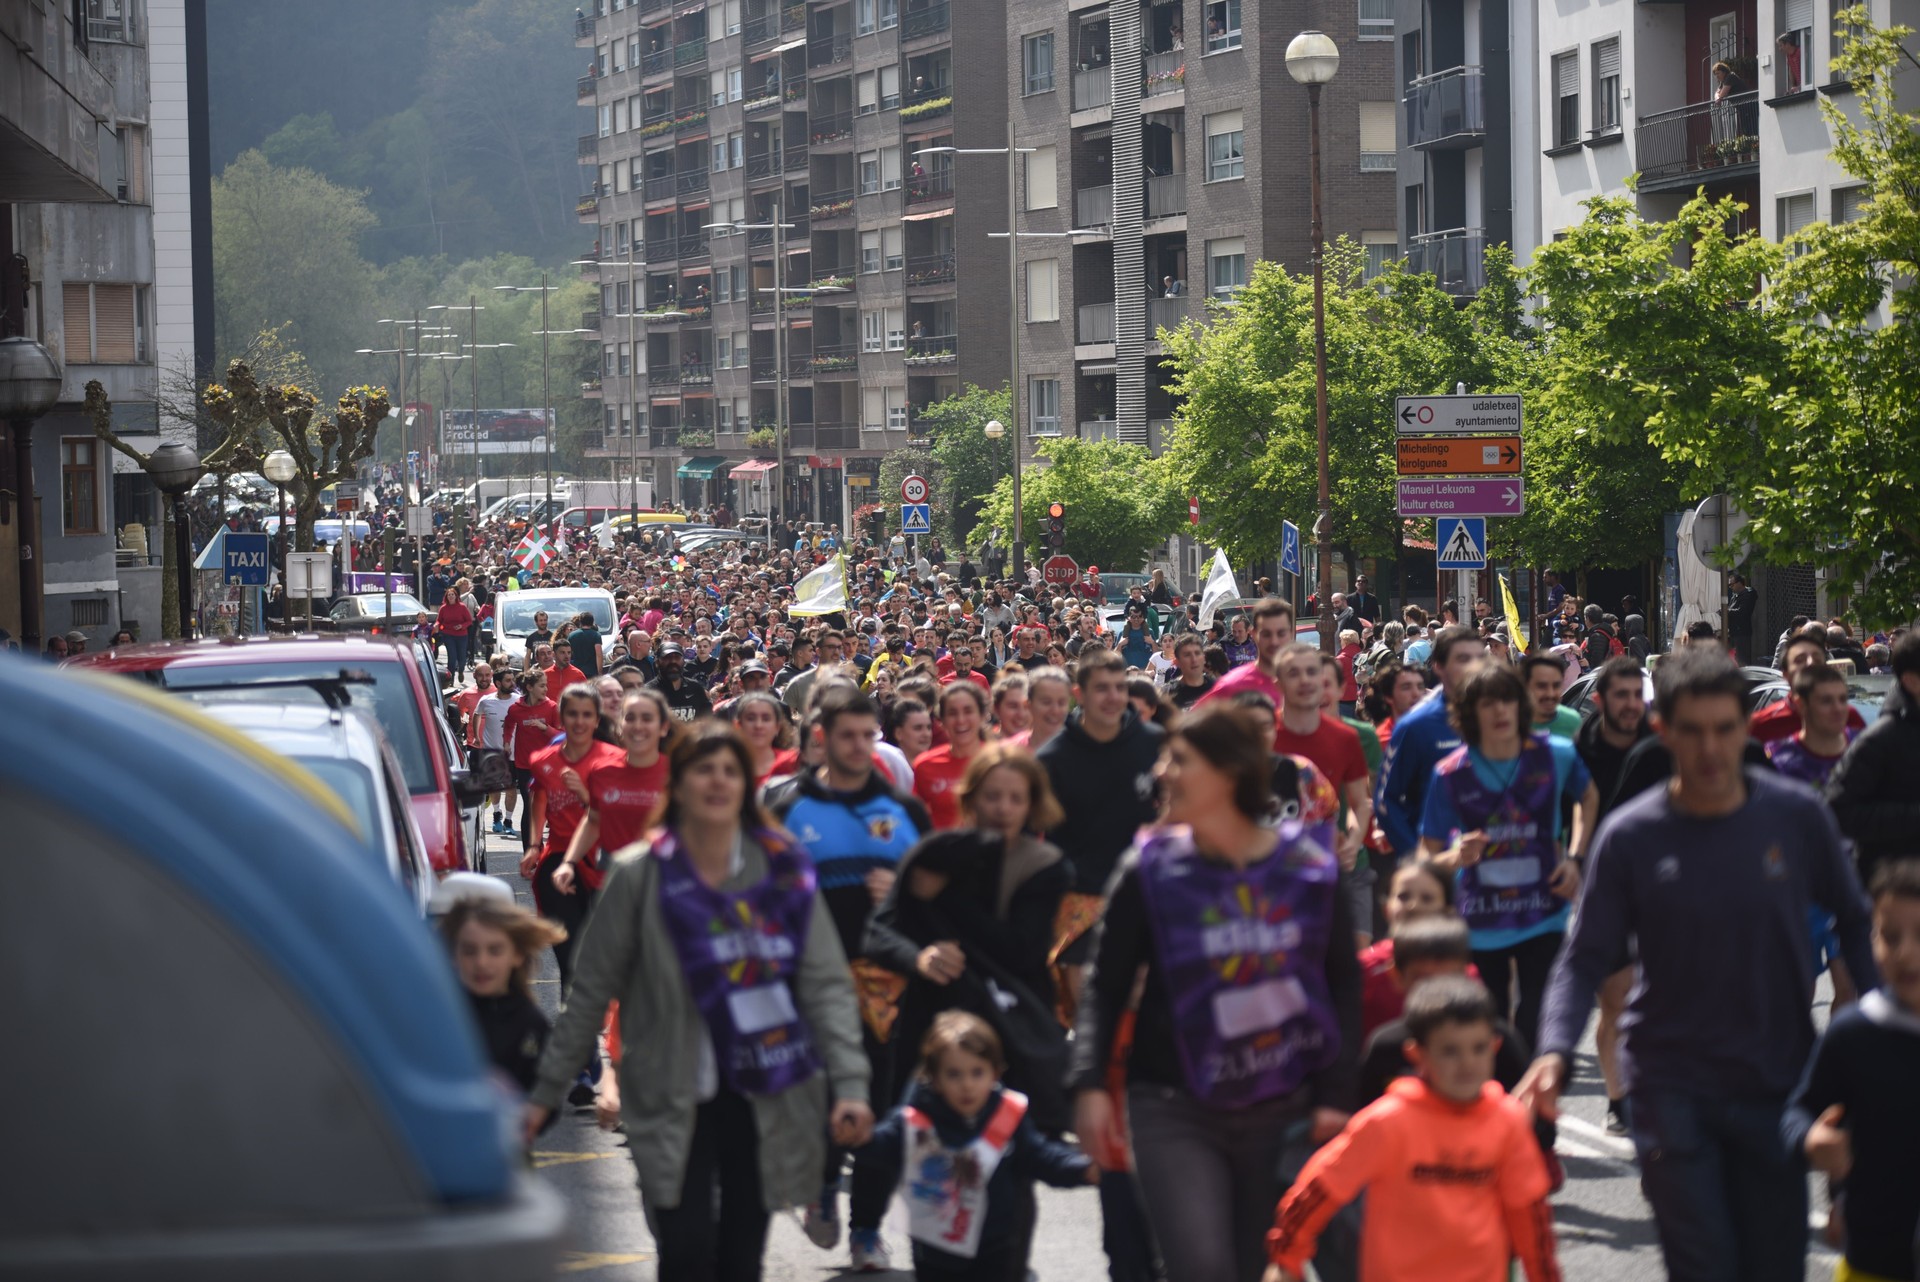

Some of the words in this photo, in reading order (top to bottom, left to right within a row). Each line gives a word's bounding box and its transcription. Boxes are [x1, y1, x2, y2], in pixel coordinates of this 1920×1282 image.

[1472, 401, 1517, 411] udaletxea
[1455, 416, 1518, 428] ayuntamiento
[1400, 444, 1449, 455] Michelingo
[1400, 458, 1448, 470] kirolgunea
[908, 485, 922, 495] 30
[1401, 484, 1434, 494] Manuel
[1436, 484, 1475, 494] Lekuona
[1401, 499, 1427, 509] kultur
[1429, 499, 1455, 509] etxea
[228, 551, 265, 567] TAXI
[1047, 566, 1075, 578] STOP
